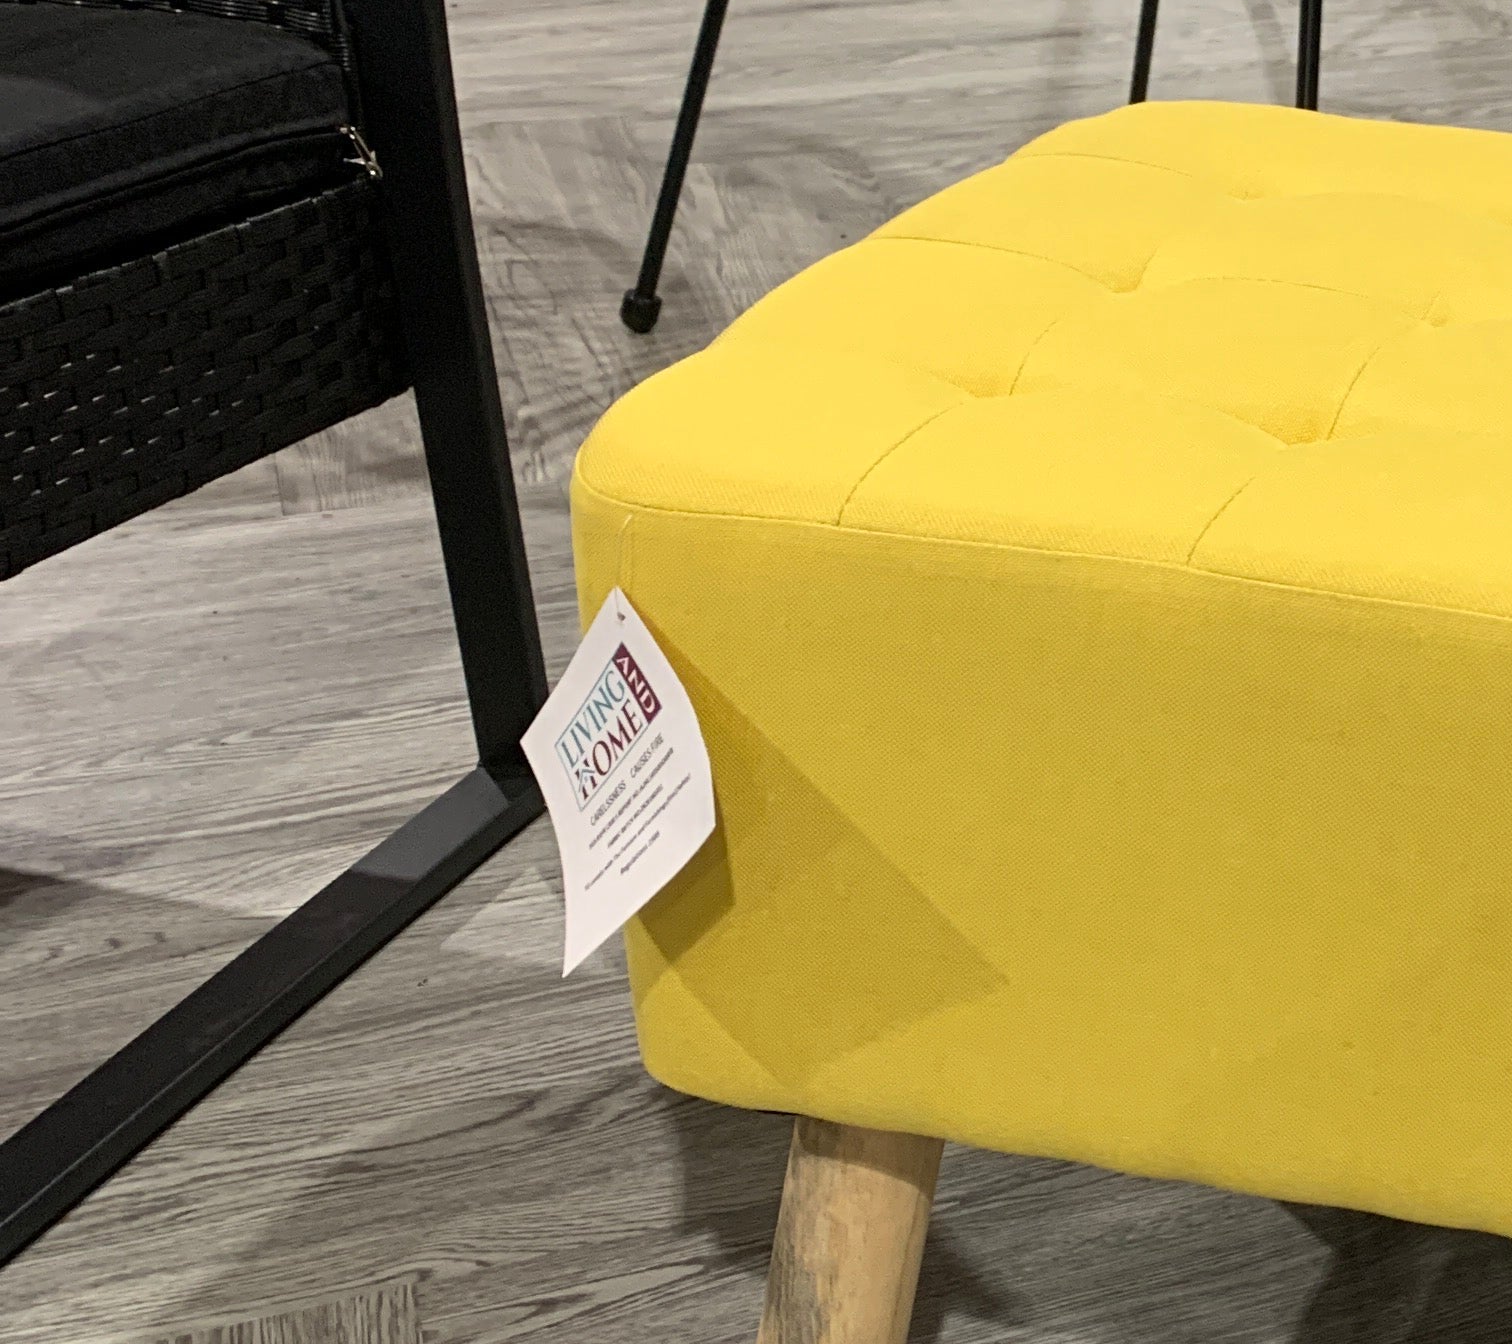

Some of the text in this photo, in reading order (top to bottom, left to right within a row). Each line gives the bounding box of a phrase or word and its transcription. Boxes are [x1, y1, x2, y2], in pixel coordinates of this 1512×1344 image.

[561, 670, 626, 768] LIVING
[616, 656, 656, 714] AND
[573, 698, 644, 801] HOME
